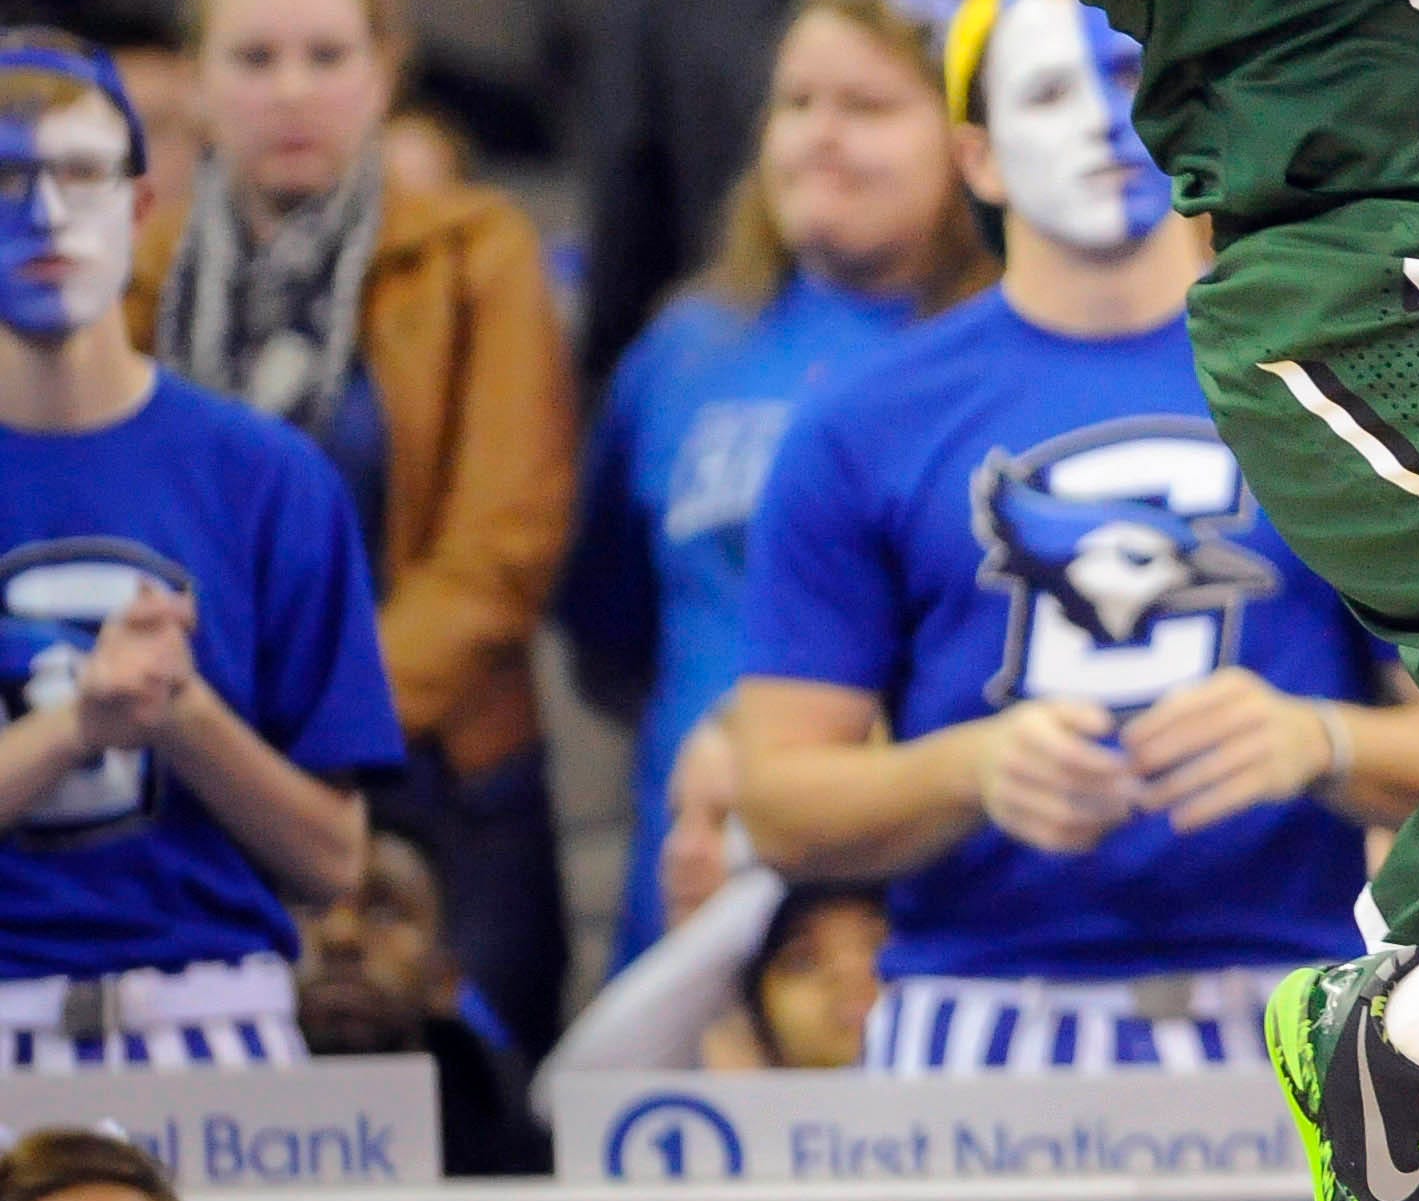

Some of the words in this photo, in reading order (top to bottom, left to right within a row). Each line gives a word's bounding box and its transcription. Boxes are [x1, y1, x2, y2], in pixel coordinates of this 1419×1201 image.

[202, 1111, 396, 1183] Bank
[789, 1119, 930, 1177] First
[953, 1118, 1290, 1177] National
